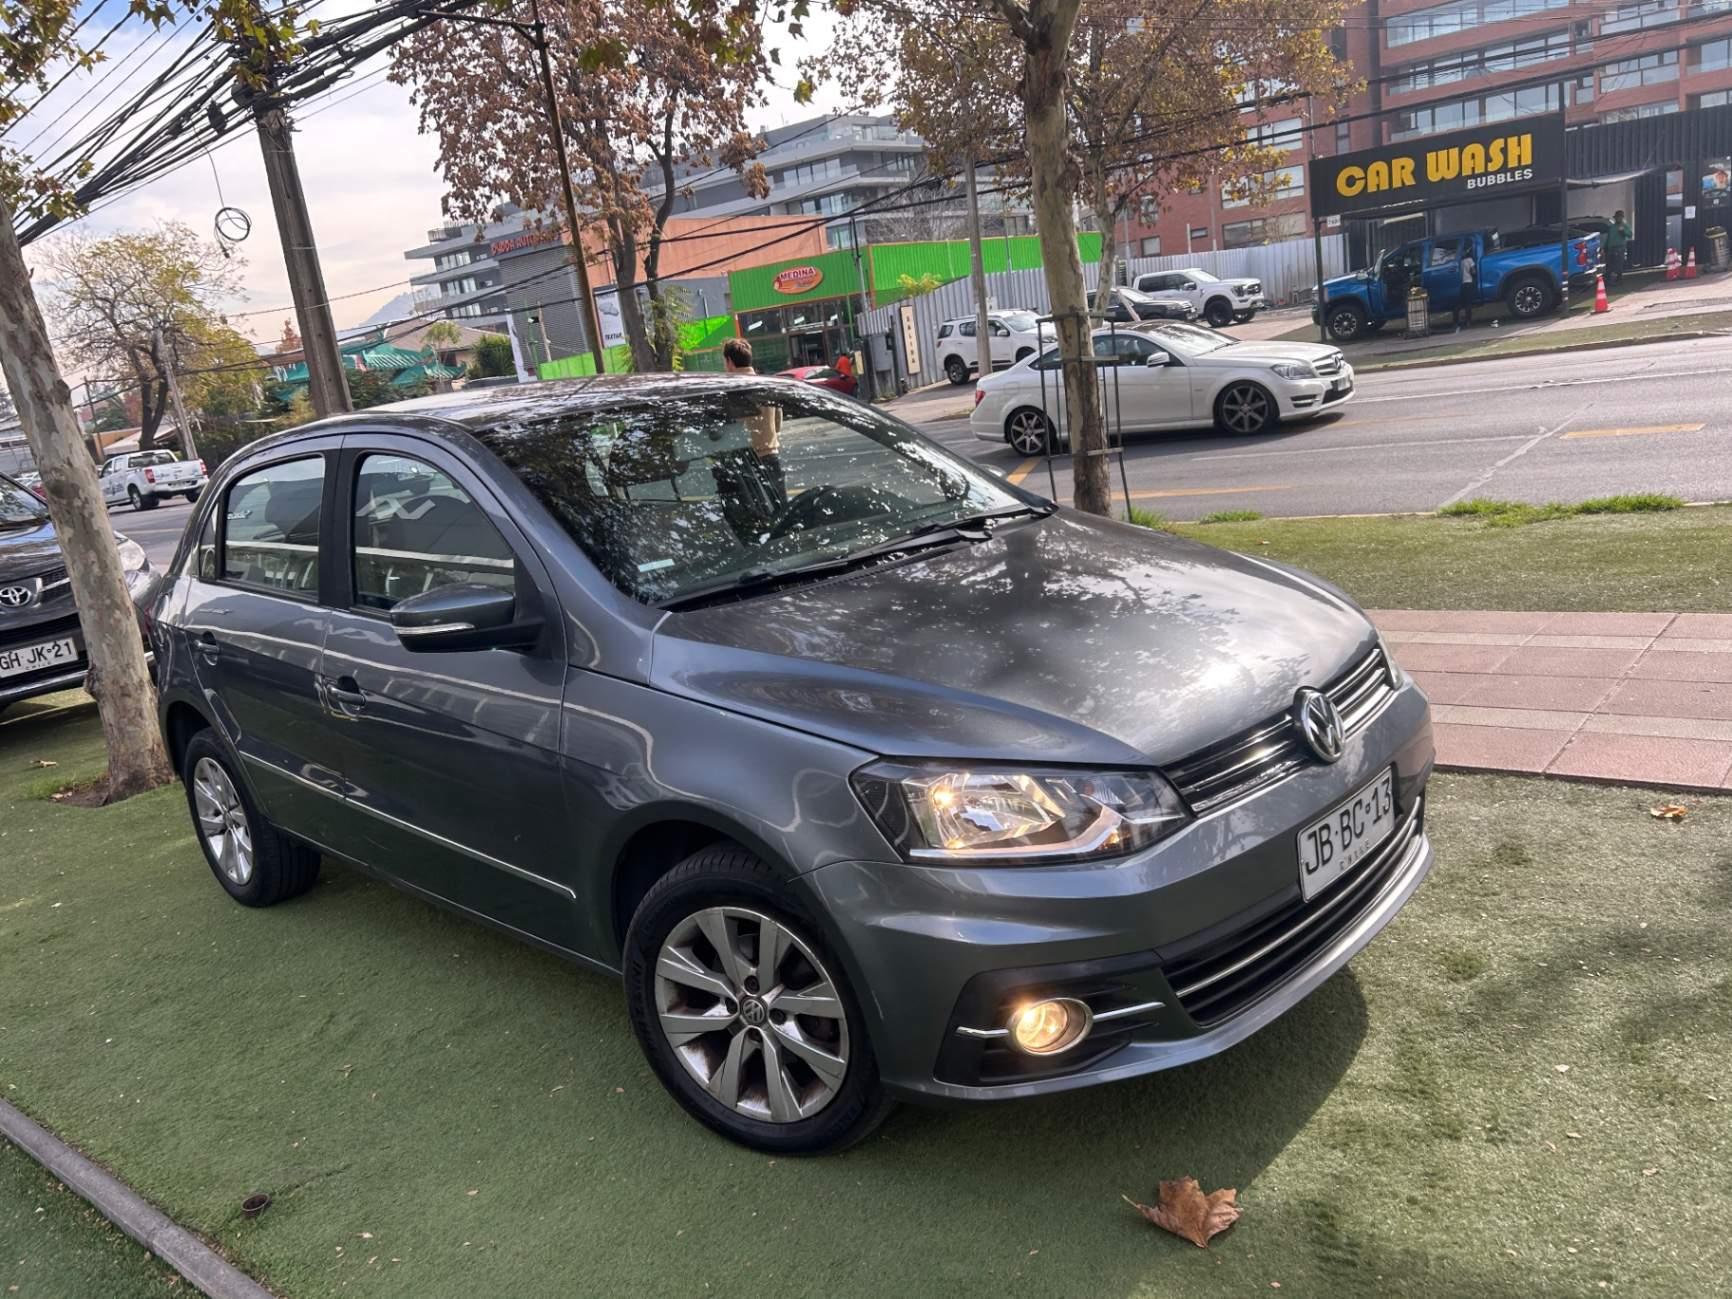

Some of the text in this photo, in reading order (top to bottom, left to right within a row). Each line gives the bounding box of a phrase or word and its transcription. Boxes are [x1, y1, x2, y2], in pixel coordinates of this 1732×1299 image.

[1336, 133, 1533, 197] CAR WASH
[1467, 168, 1533, 190] BUBBLES
[780, 267, 815, 281] MEDINA
